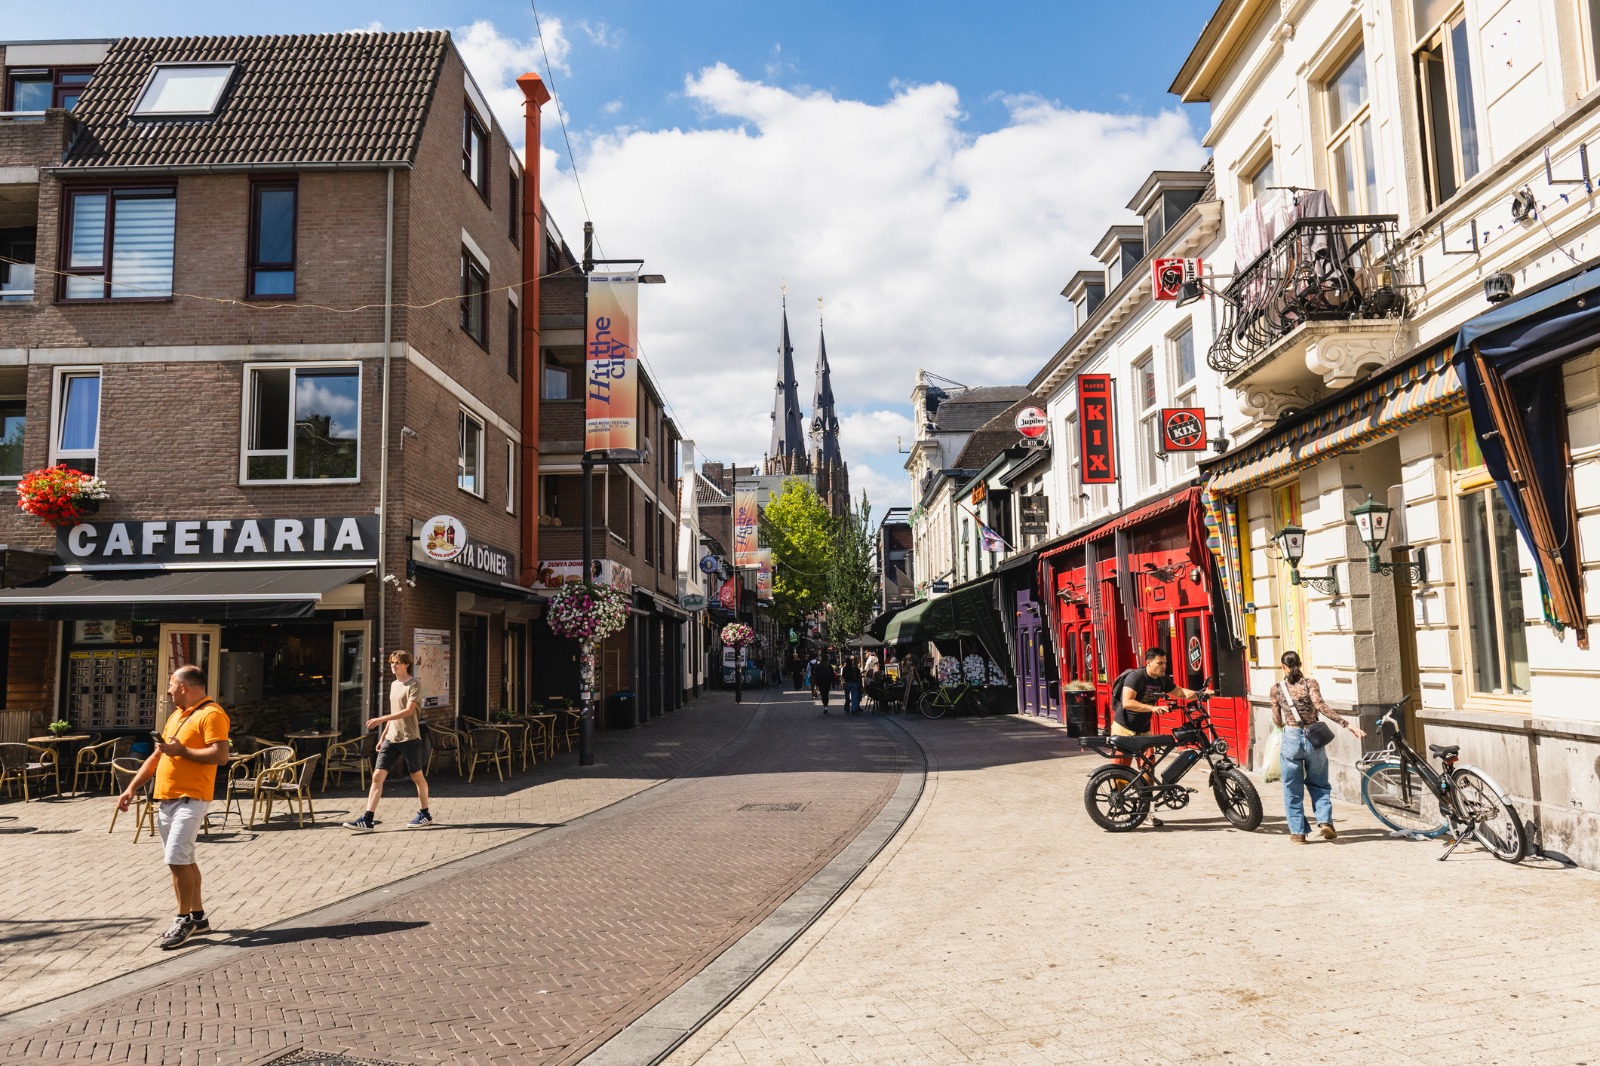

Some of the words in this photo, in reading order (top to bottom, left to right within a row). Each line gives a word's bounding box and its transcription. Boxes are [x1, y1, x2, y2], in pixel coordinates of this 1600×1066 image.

[589, 316, 611, 357] the
[608, 337, 634, 379] city
[589, 359, 611, 405] Hit
[1021, 418, 1045, 426] Jupiler
[1086, 404, 1108, 471] KIX
[1172, 423, 1198, 438] KIX
[67, 517, 364, 557] CAFETARIA
